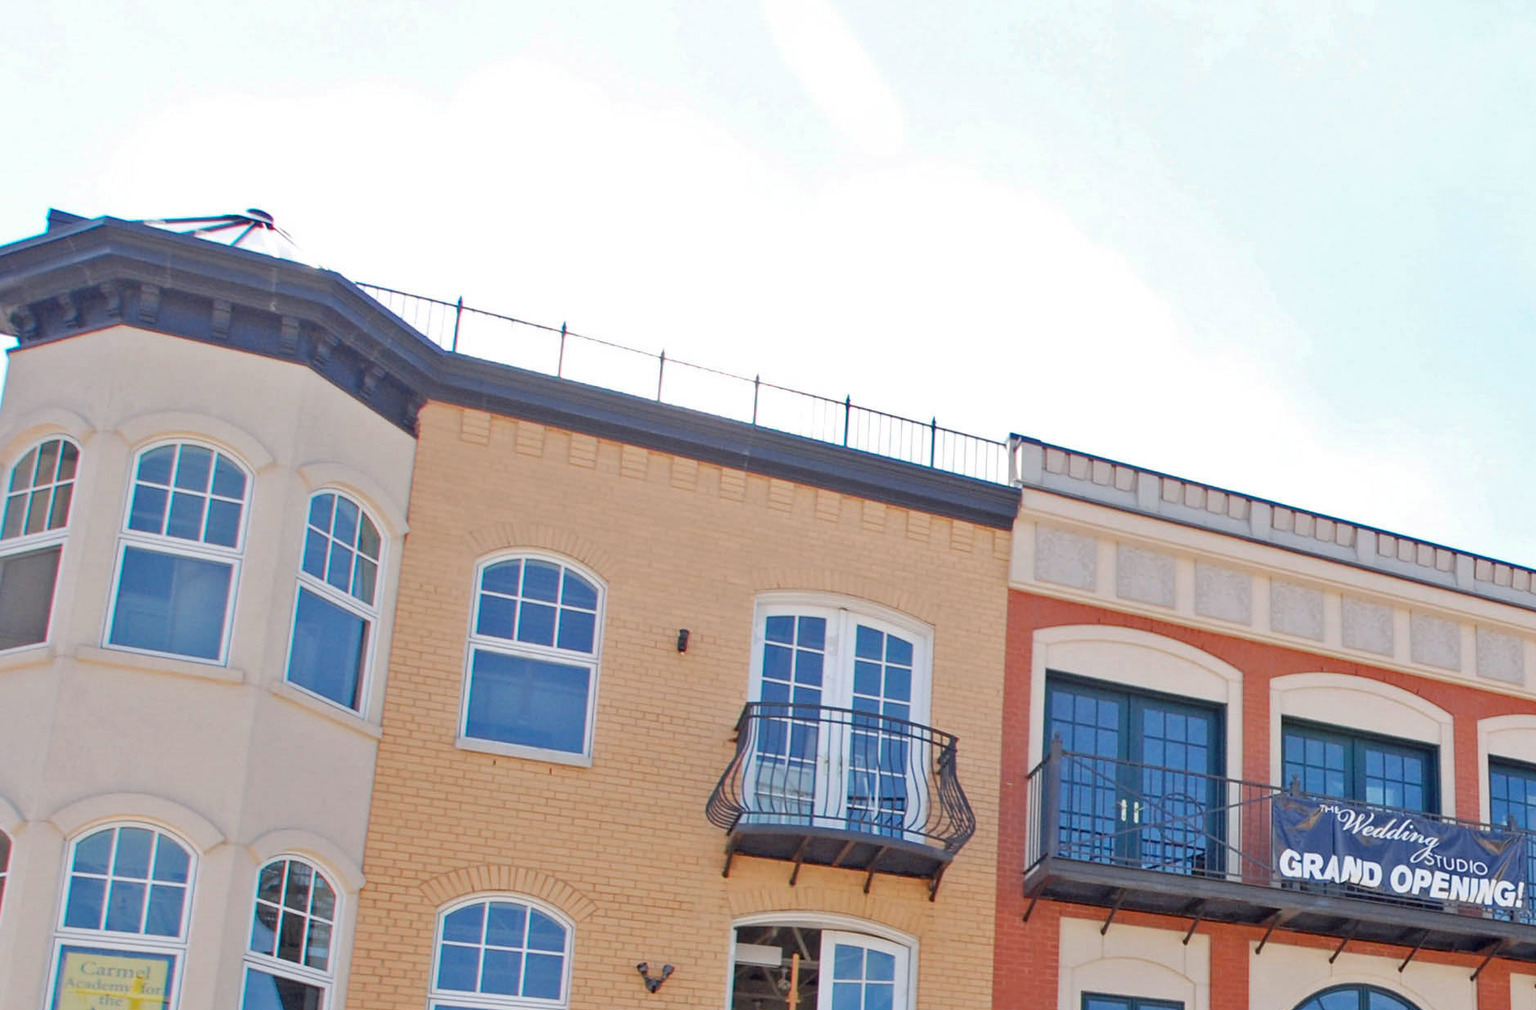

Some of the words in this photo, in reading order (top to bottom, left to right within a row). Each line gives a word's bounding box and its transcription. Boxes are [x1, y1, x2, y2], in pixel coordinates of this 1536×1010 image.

[1320, 804, 1340, 816] THE
[1338, 808, 1439, 864] Wedding
[1424, 852, 1488, 876] STUDIO
[1280, 848, 1383, 889] GRAND
[1390, 864, 1525, 908] OPENING!
[80, 961, 152, 980] Carmel
[100, 993, 122, 1007] the
